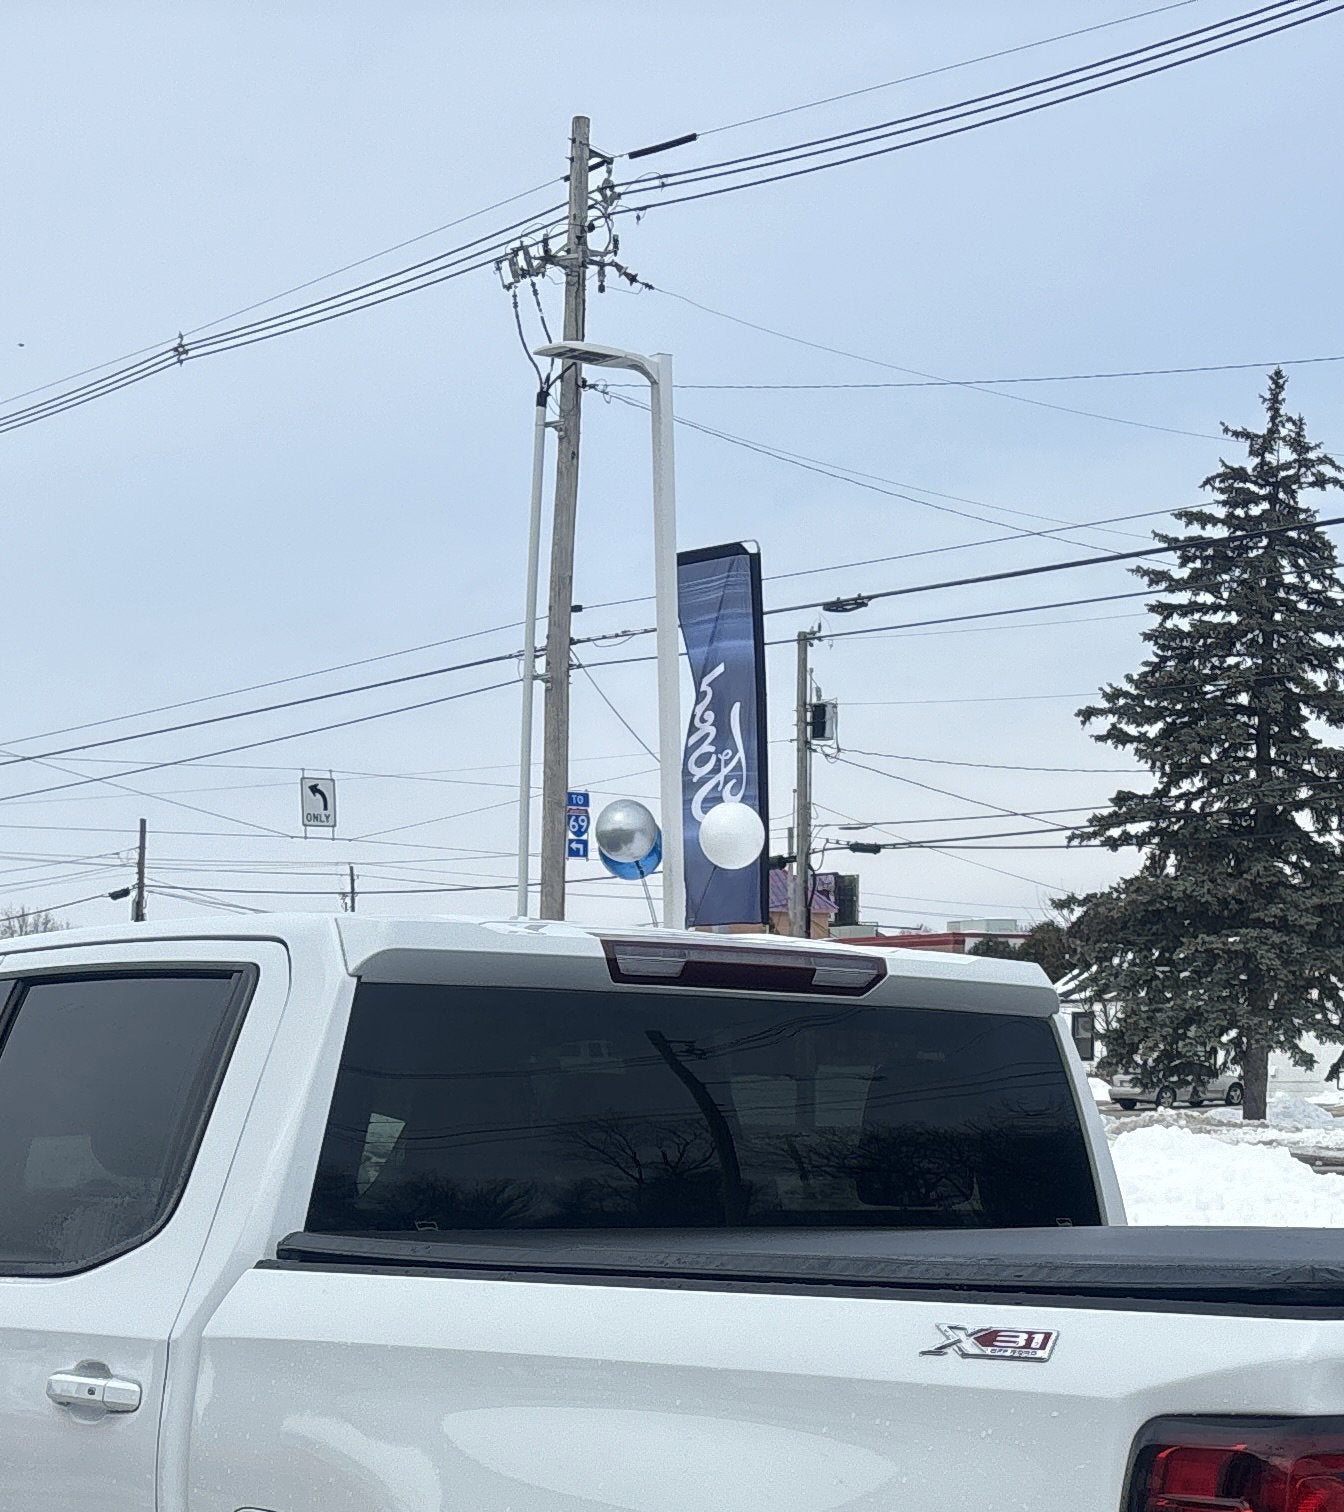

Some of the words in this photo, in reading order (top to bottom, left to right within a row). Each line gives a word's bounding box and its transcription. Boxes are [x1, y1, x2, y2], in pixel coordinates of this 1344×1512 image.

[571, 794, 584, 805] TO
[306, 812, 331, 823] ONLY
[569, 815, 588, 832] 69
